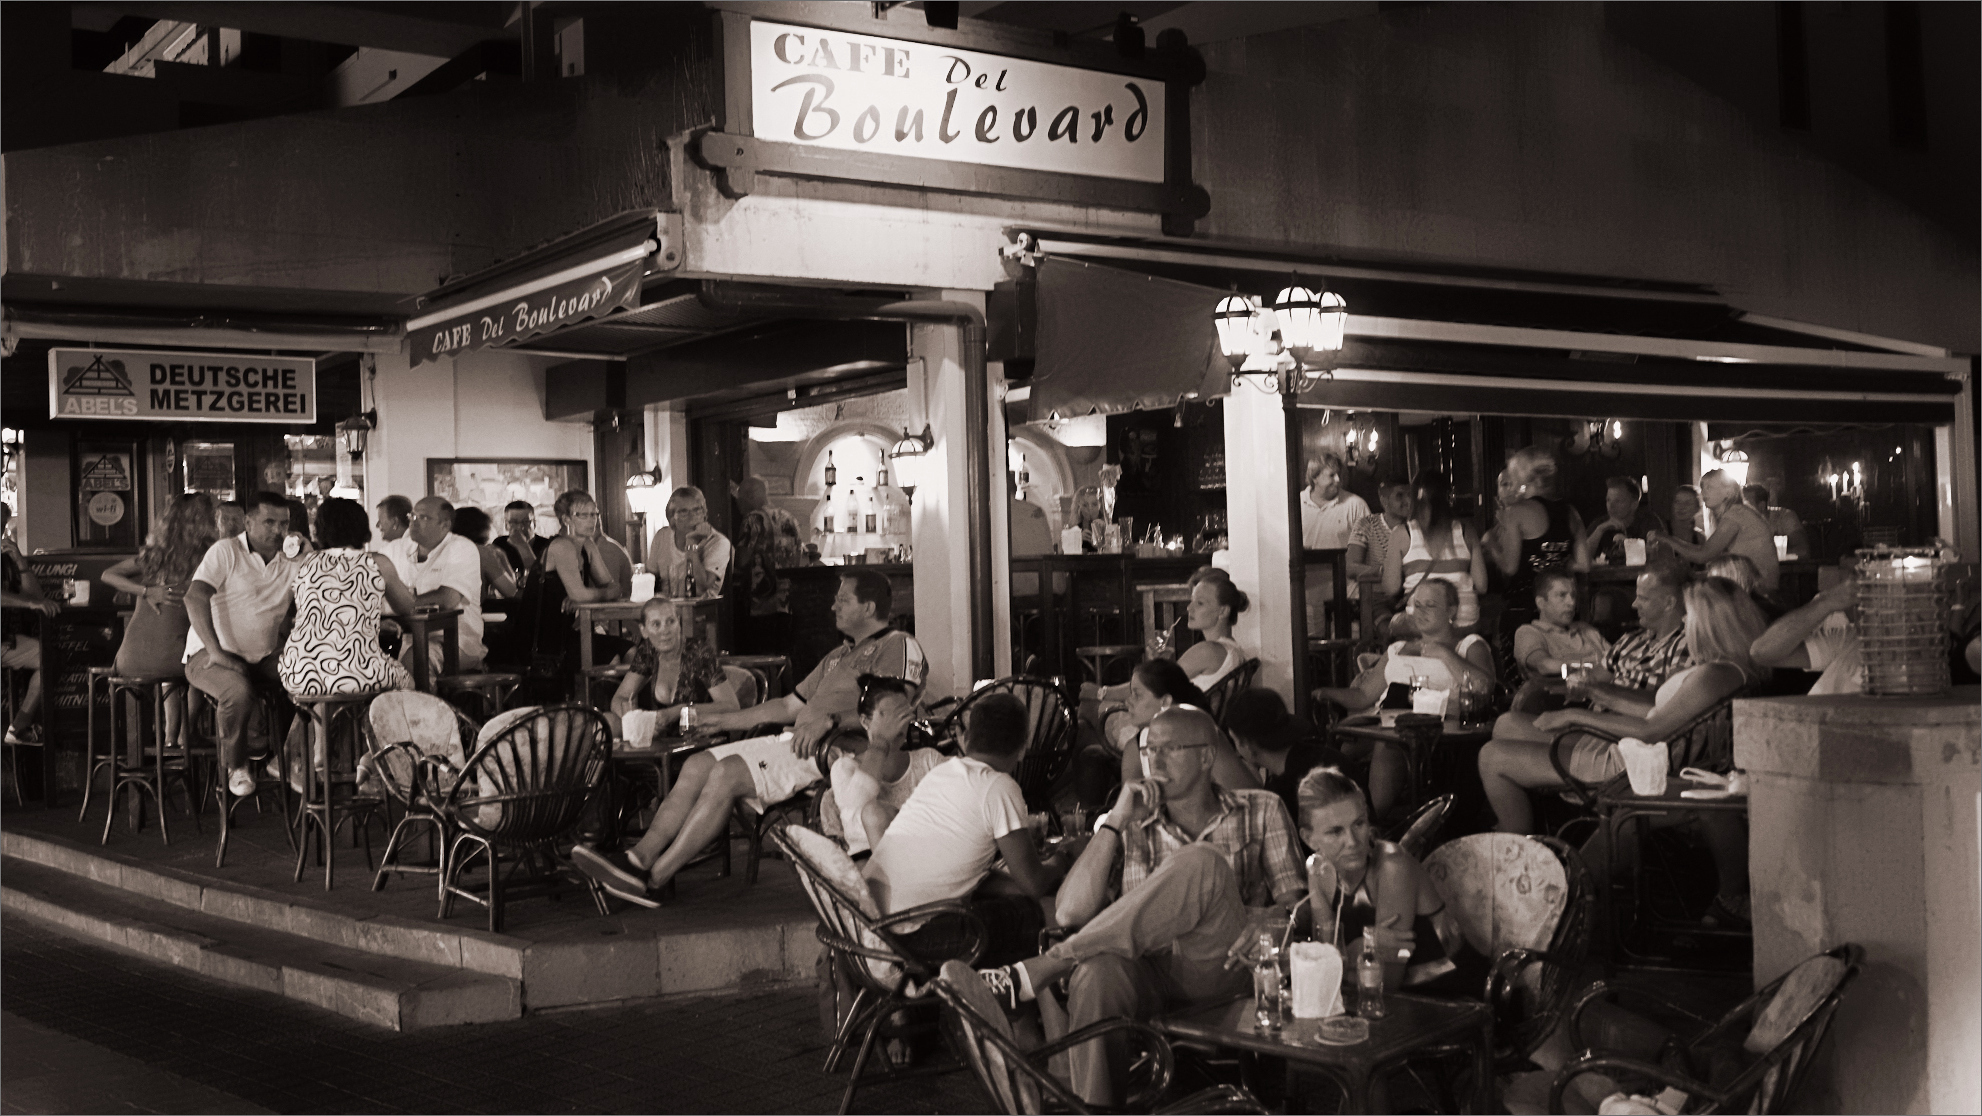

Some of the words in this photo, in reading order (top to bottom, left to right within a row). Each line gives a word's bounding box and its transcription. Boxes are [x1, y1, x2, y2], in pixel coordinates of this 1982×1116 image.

[773, 32, 911, 80] CAFE
[939, 55, 1008, 92] Del
[771, 73, 1149, 144] Boulevard
[432, 323, 472, 354] CAFE
[480, 315, 504, 341] Del
[511, 275, 613, 333] Boulevard
[149, 363, 297, 390] DEUTSCHE
[149, 388, 306, 414] METZGEREI
